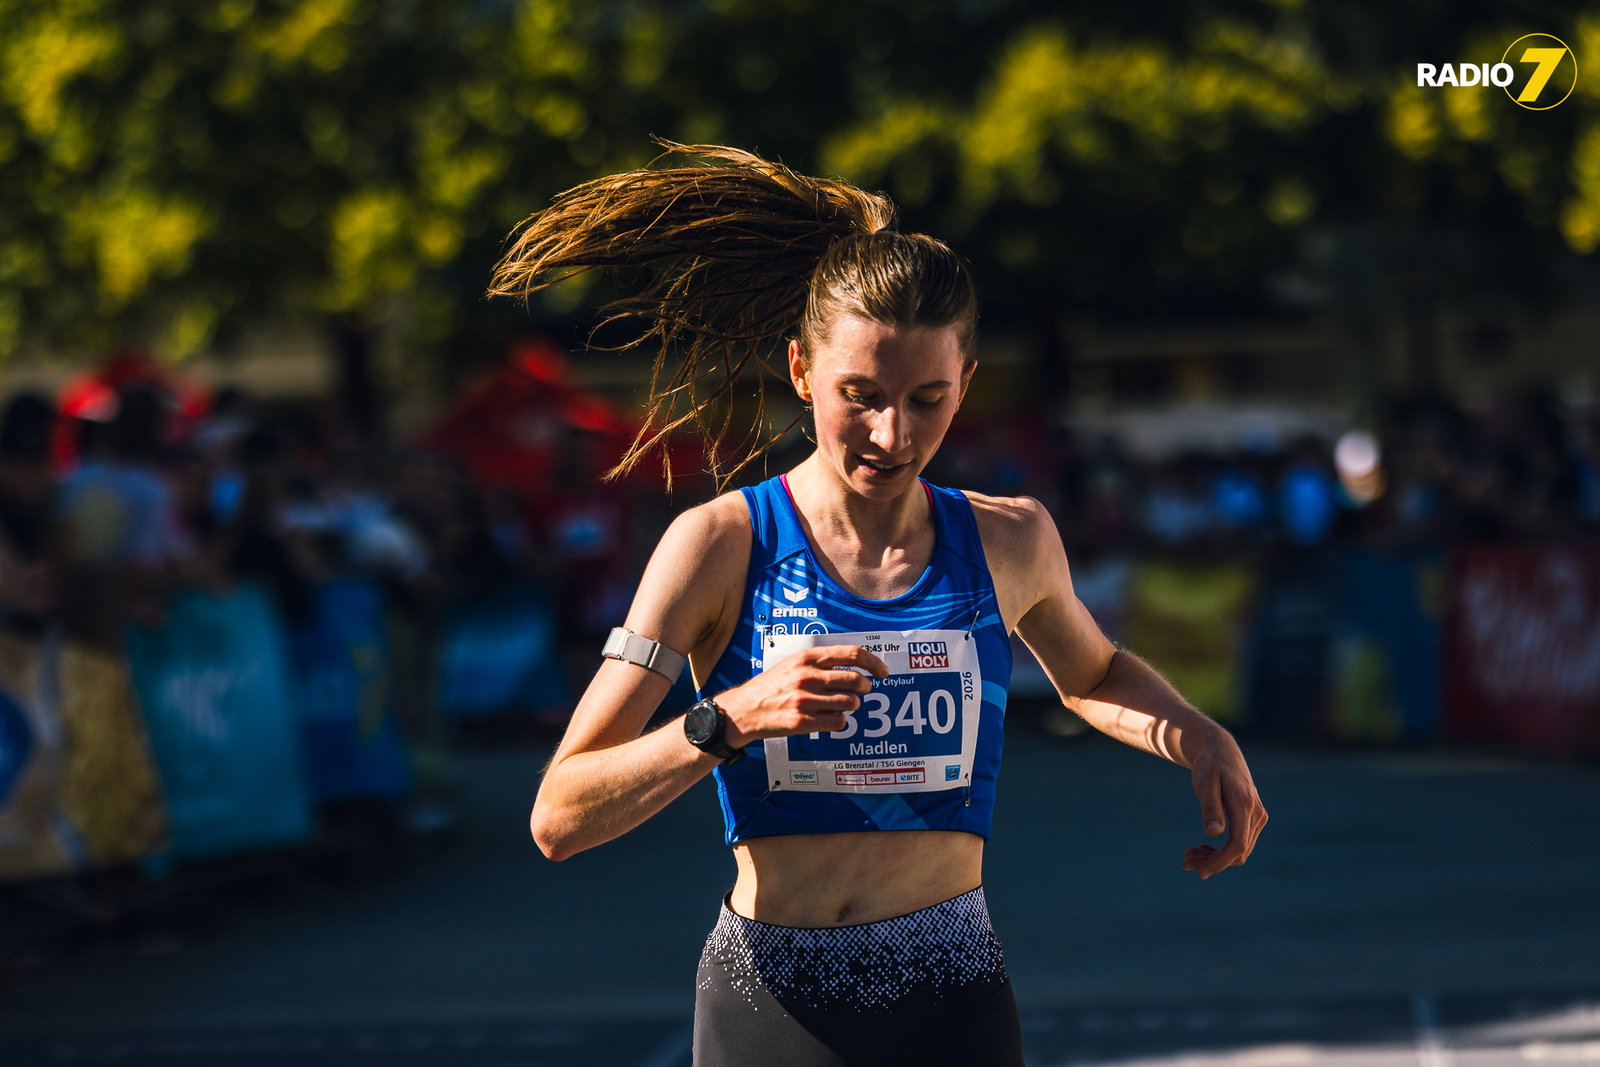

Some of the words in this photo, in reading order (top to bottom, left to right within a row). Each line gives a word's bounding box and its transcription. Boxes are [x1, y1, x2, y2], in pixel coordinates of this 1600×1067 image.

[772, 606, 818, 617] erima
[884, 643, 901, 652] Uhr
[909, 642, 945, 655] LIQUI
[911, 655, 948, 668] MOLY
[882, 676, 915, 687] Citylauf
[962, 671, 974, 701] 2026
[809, 689, 956, 740] 3340
[850, 741, 908, 756] Madlen
[896, 760, 926, 768] Giengen
